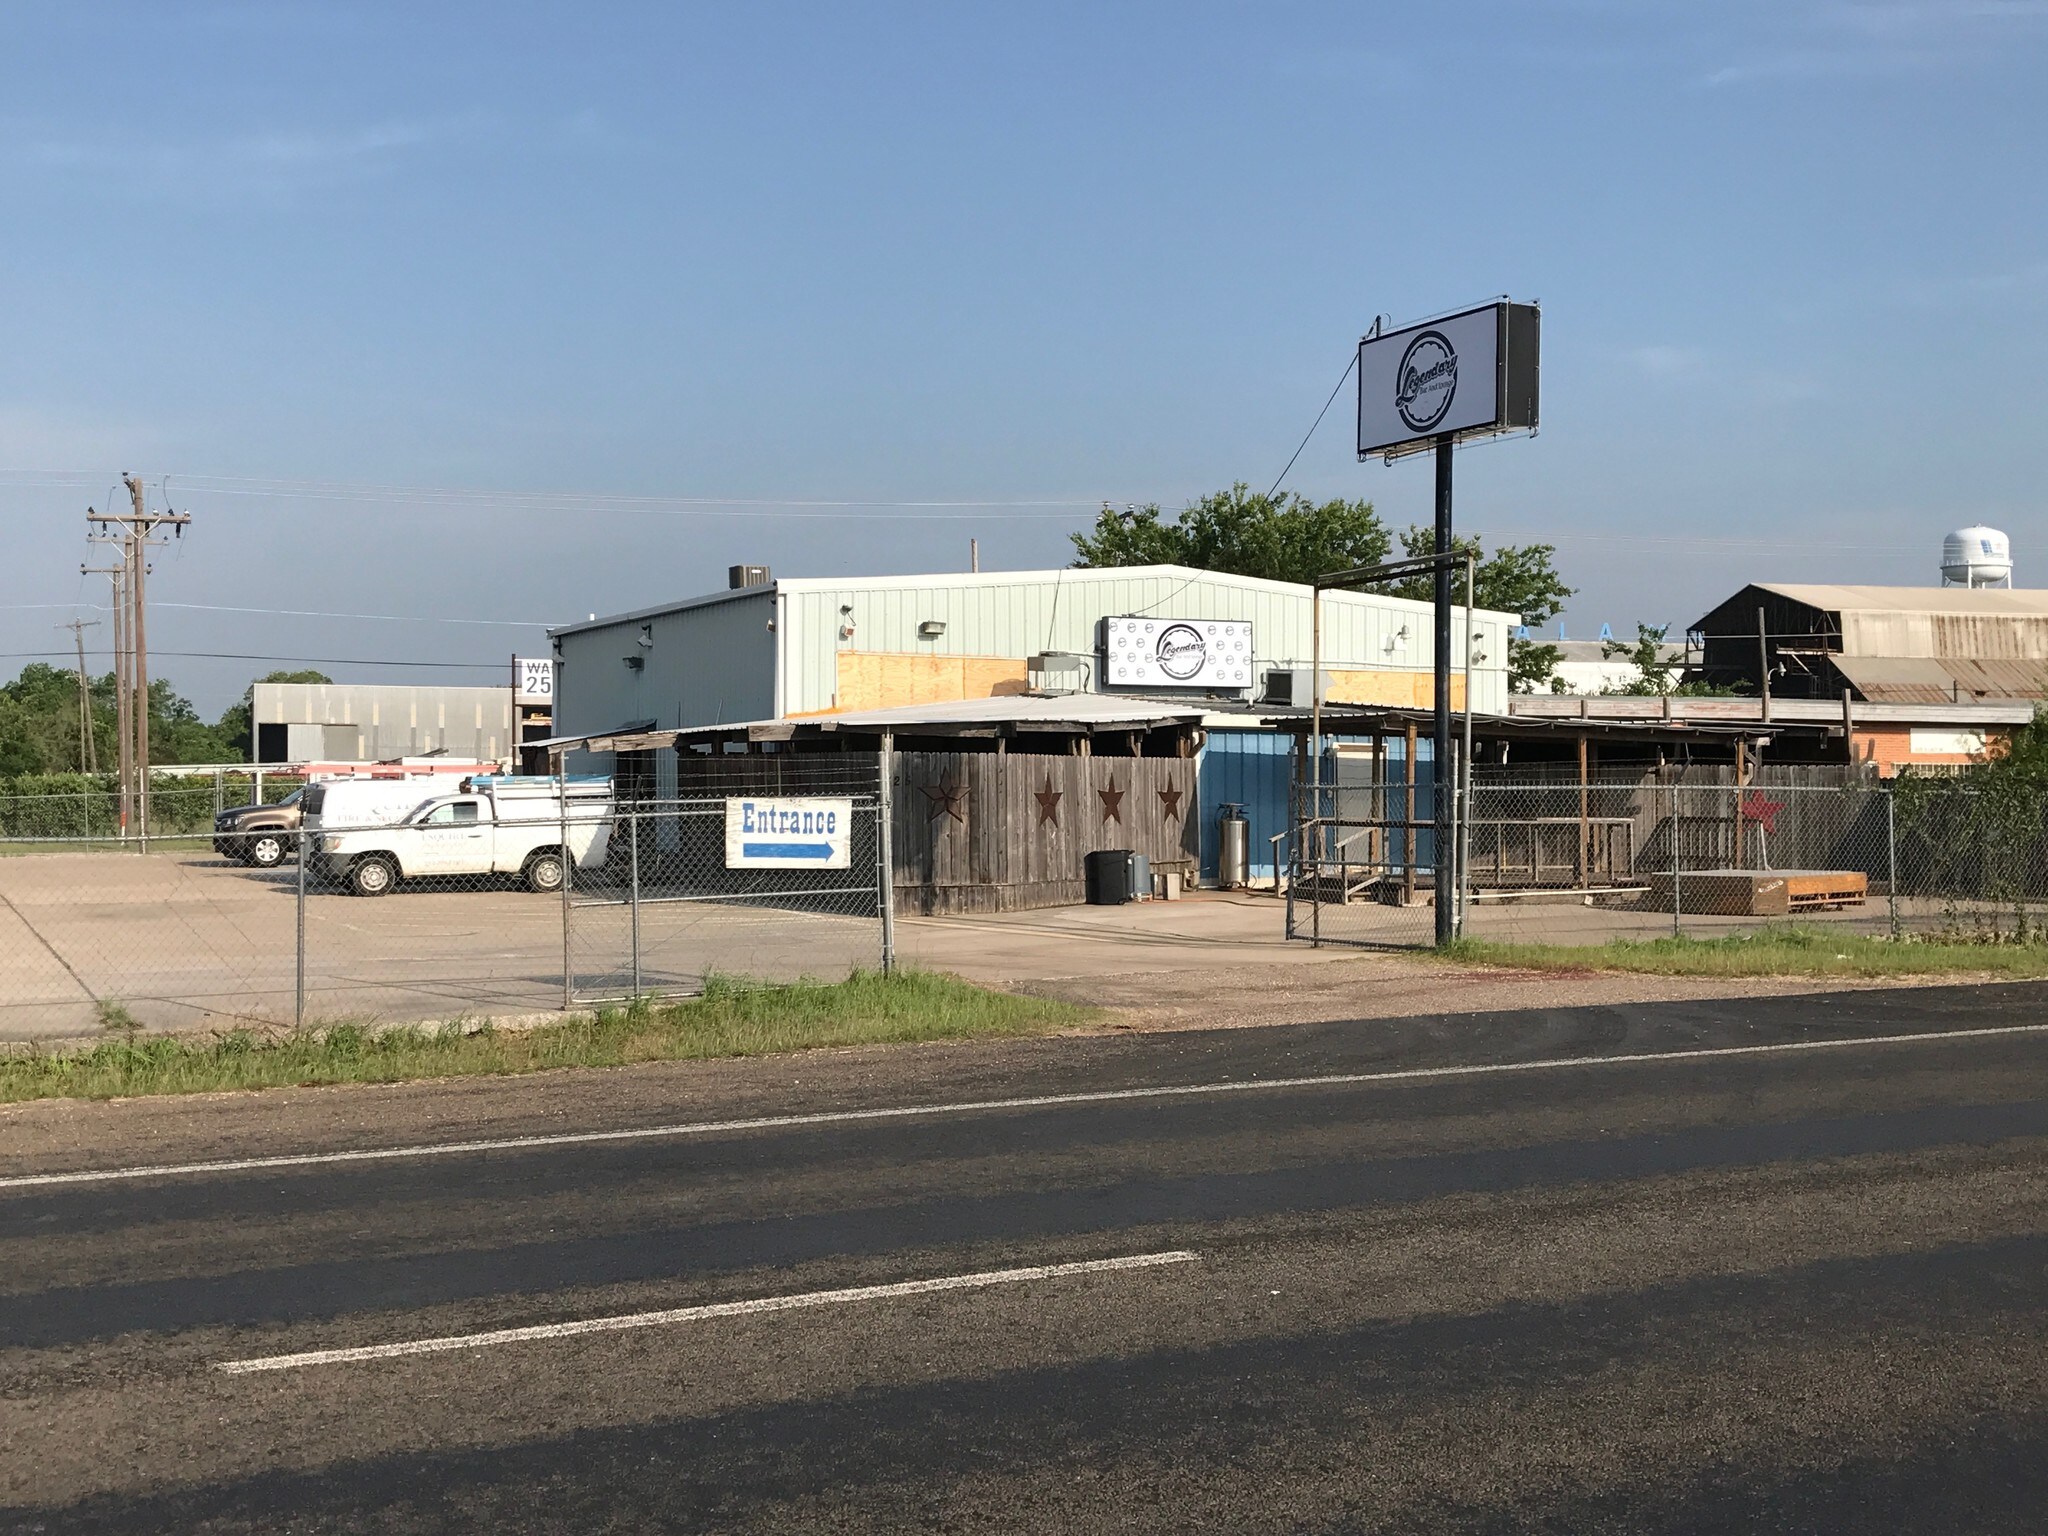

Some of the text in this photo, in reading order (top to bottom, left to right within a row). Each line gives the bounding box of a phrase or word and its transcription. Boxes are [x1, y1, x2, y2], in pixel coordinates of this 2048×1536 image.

[1395, 354, 1458, 408] Legendary
[1155, 640, 1206, 662] Legendary
[742, 802, 836, 835] Entrance
